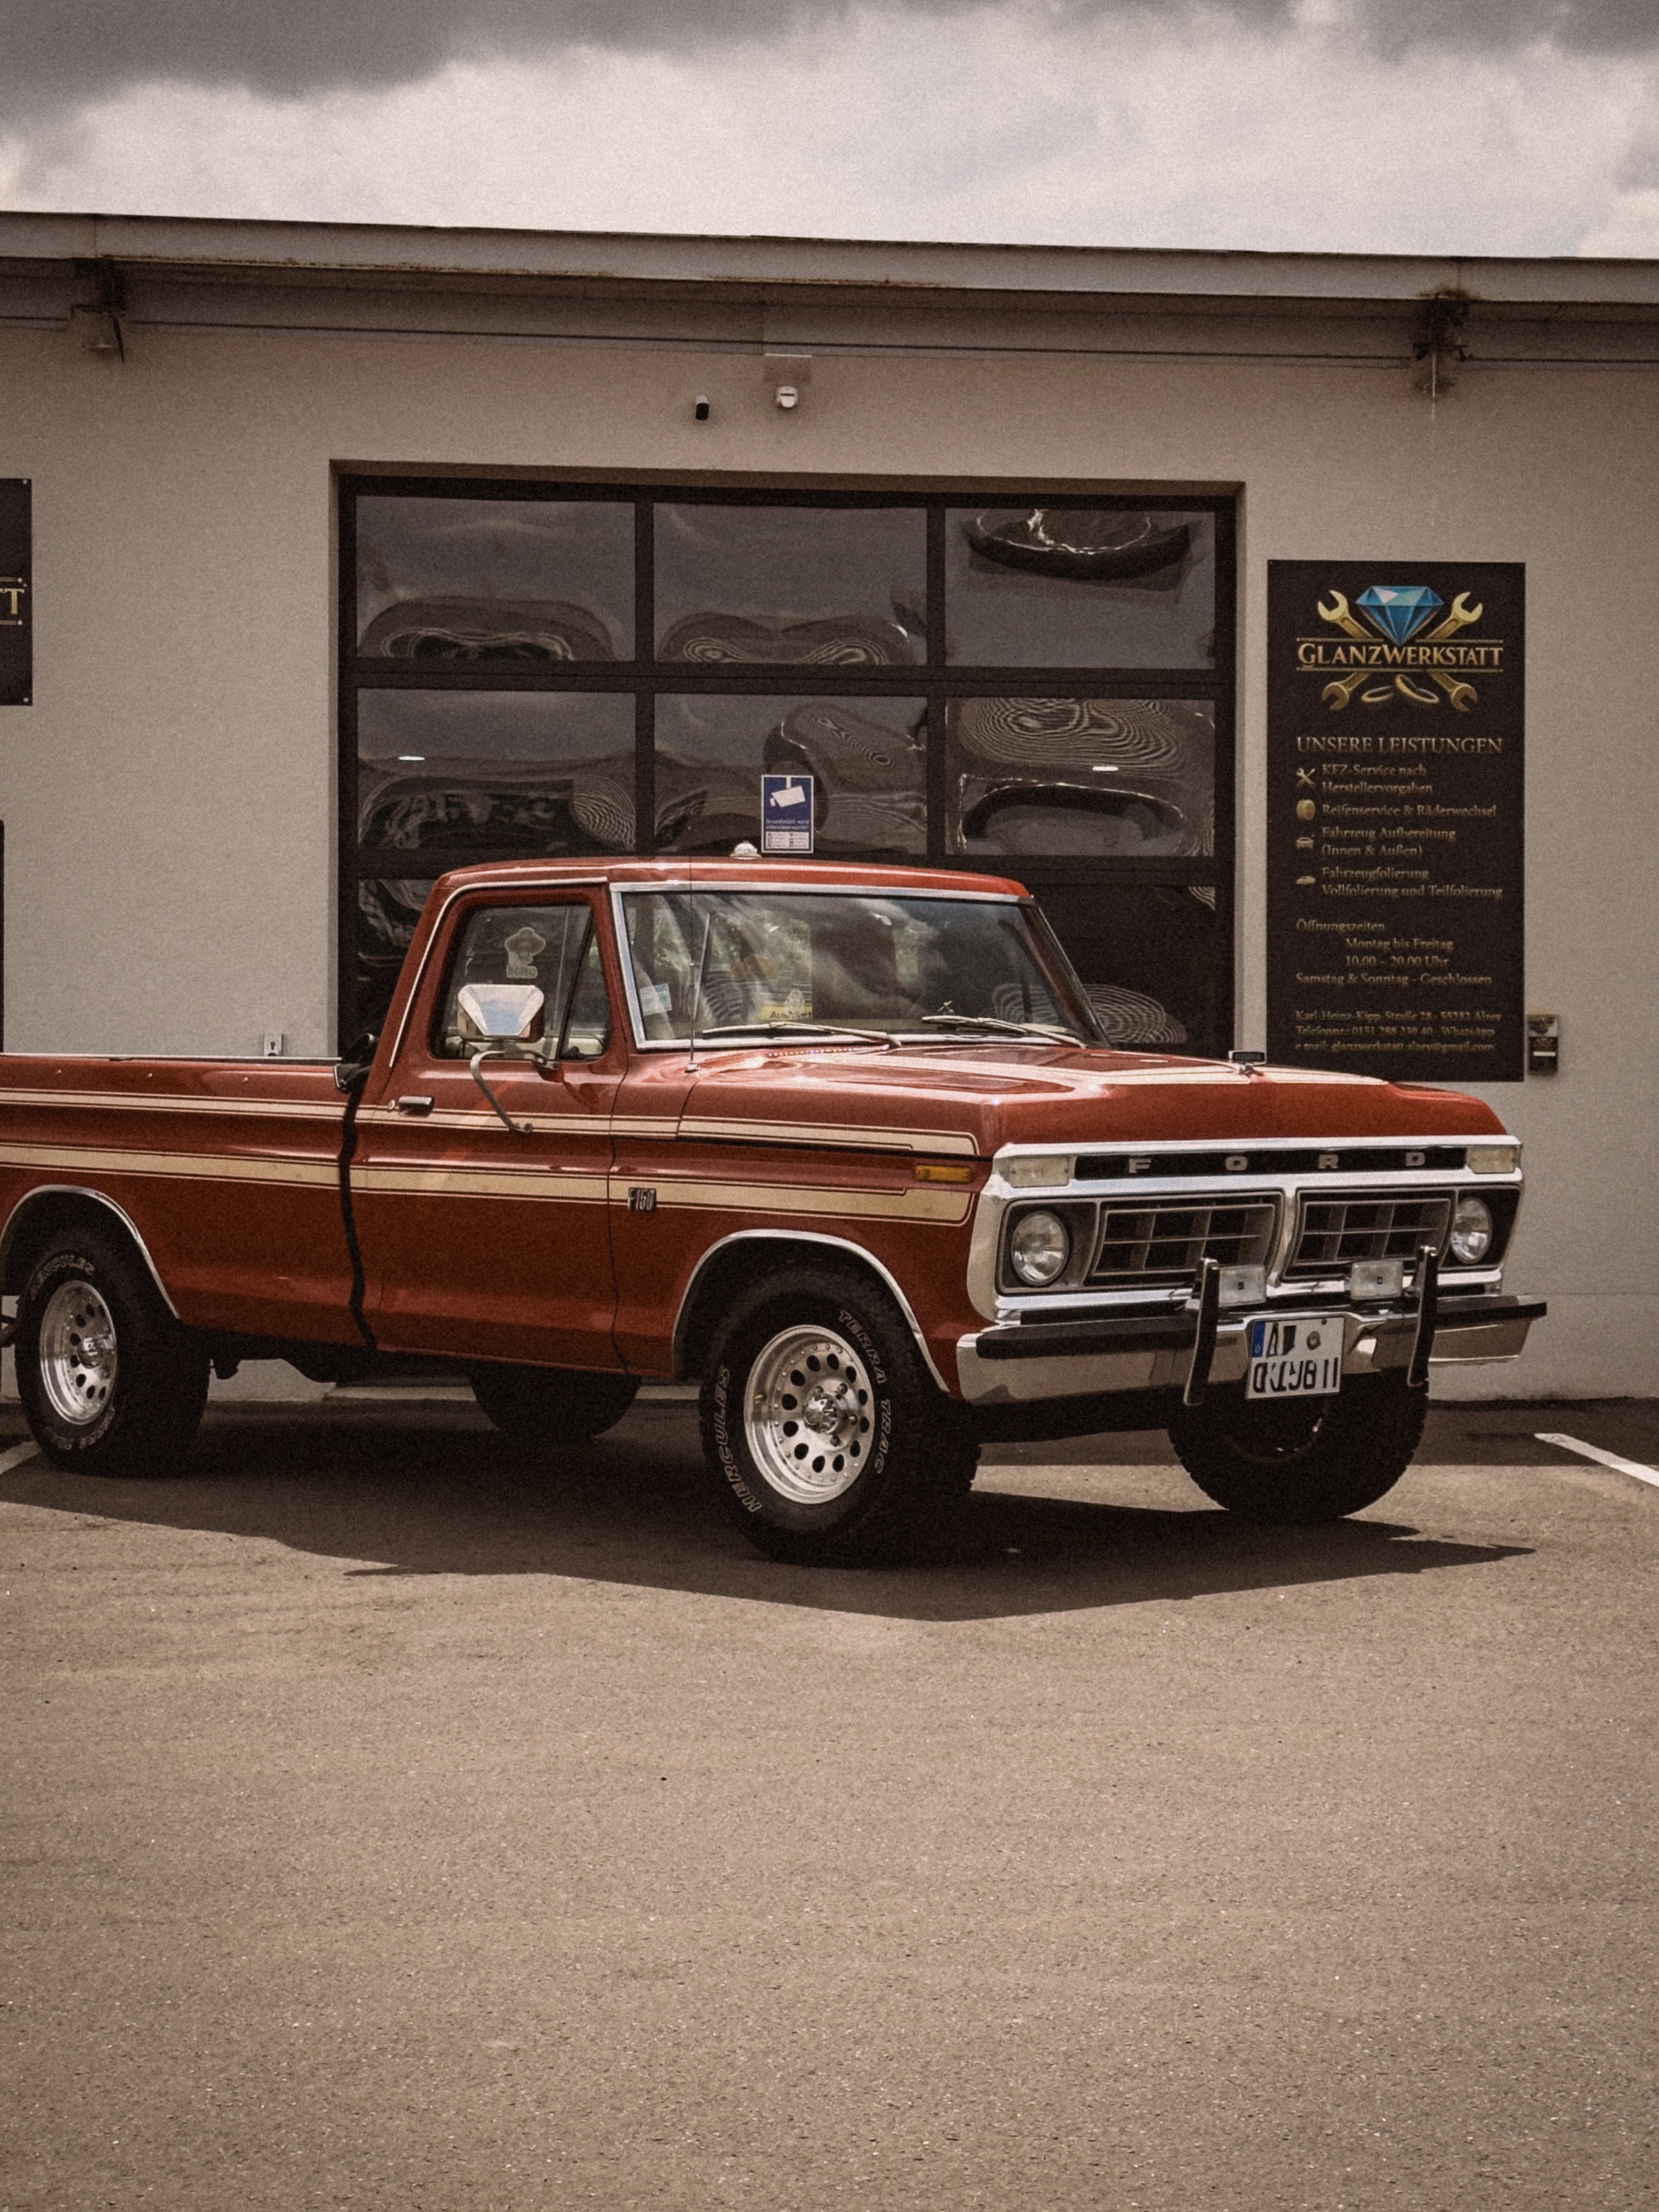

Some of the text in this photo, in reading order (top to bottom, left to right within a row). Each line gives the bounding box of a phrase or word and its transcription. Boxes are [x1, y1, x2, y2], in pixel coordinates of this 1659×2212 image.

[1297, 643, 1504, 667] GLANZWERKSTATT
[1296, 736, 1503, 754] UNSERE LEISTUNGEN
[1322, 763, 1427, 776] KFZ-Service nach
[1322, 781, 1433, 796] Herstellervorgaben
[1322, 804, 1497, 817] Reifenservice & Räderwechsel
[1322, 826, 1456, 842] Fahrzeug Aufbereitung
[1322, 844, 1423, 857] (Innen & Außen)
[1322, 867, 1429, 881] Fahrzeugfolierung
[1321, 884, 1504, 899] Vollfolierung und Teilfolierung
[1345, 937, 1454, 953] Montag bis Freitag
[1424, 955, 1449, 967] Uhr
[1295, 973, 1345, 986] Samstag
[1347, 973, 1358, 985] &
[1361, 973, 1409, 987] Sonntag
[1420, 973, 1492, 985] Geschlossen
[1128, 1151, 1426, 1174] FORD
[838, 1309, 891, 1474] TERRA TRAC
[713, 1365, 763, 1513] HERCULES
